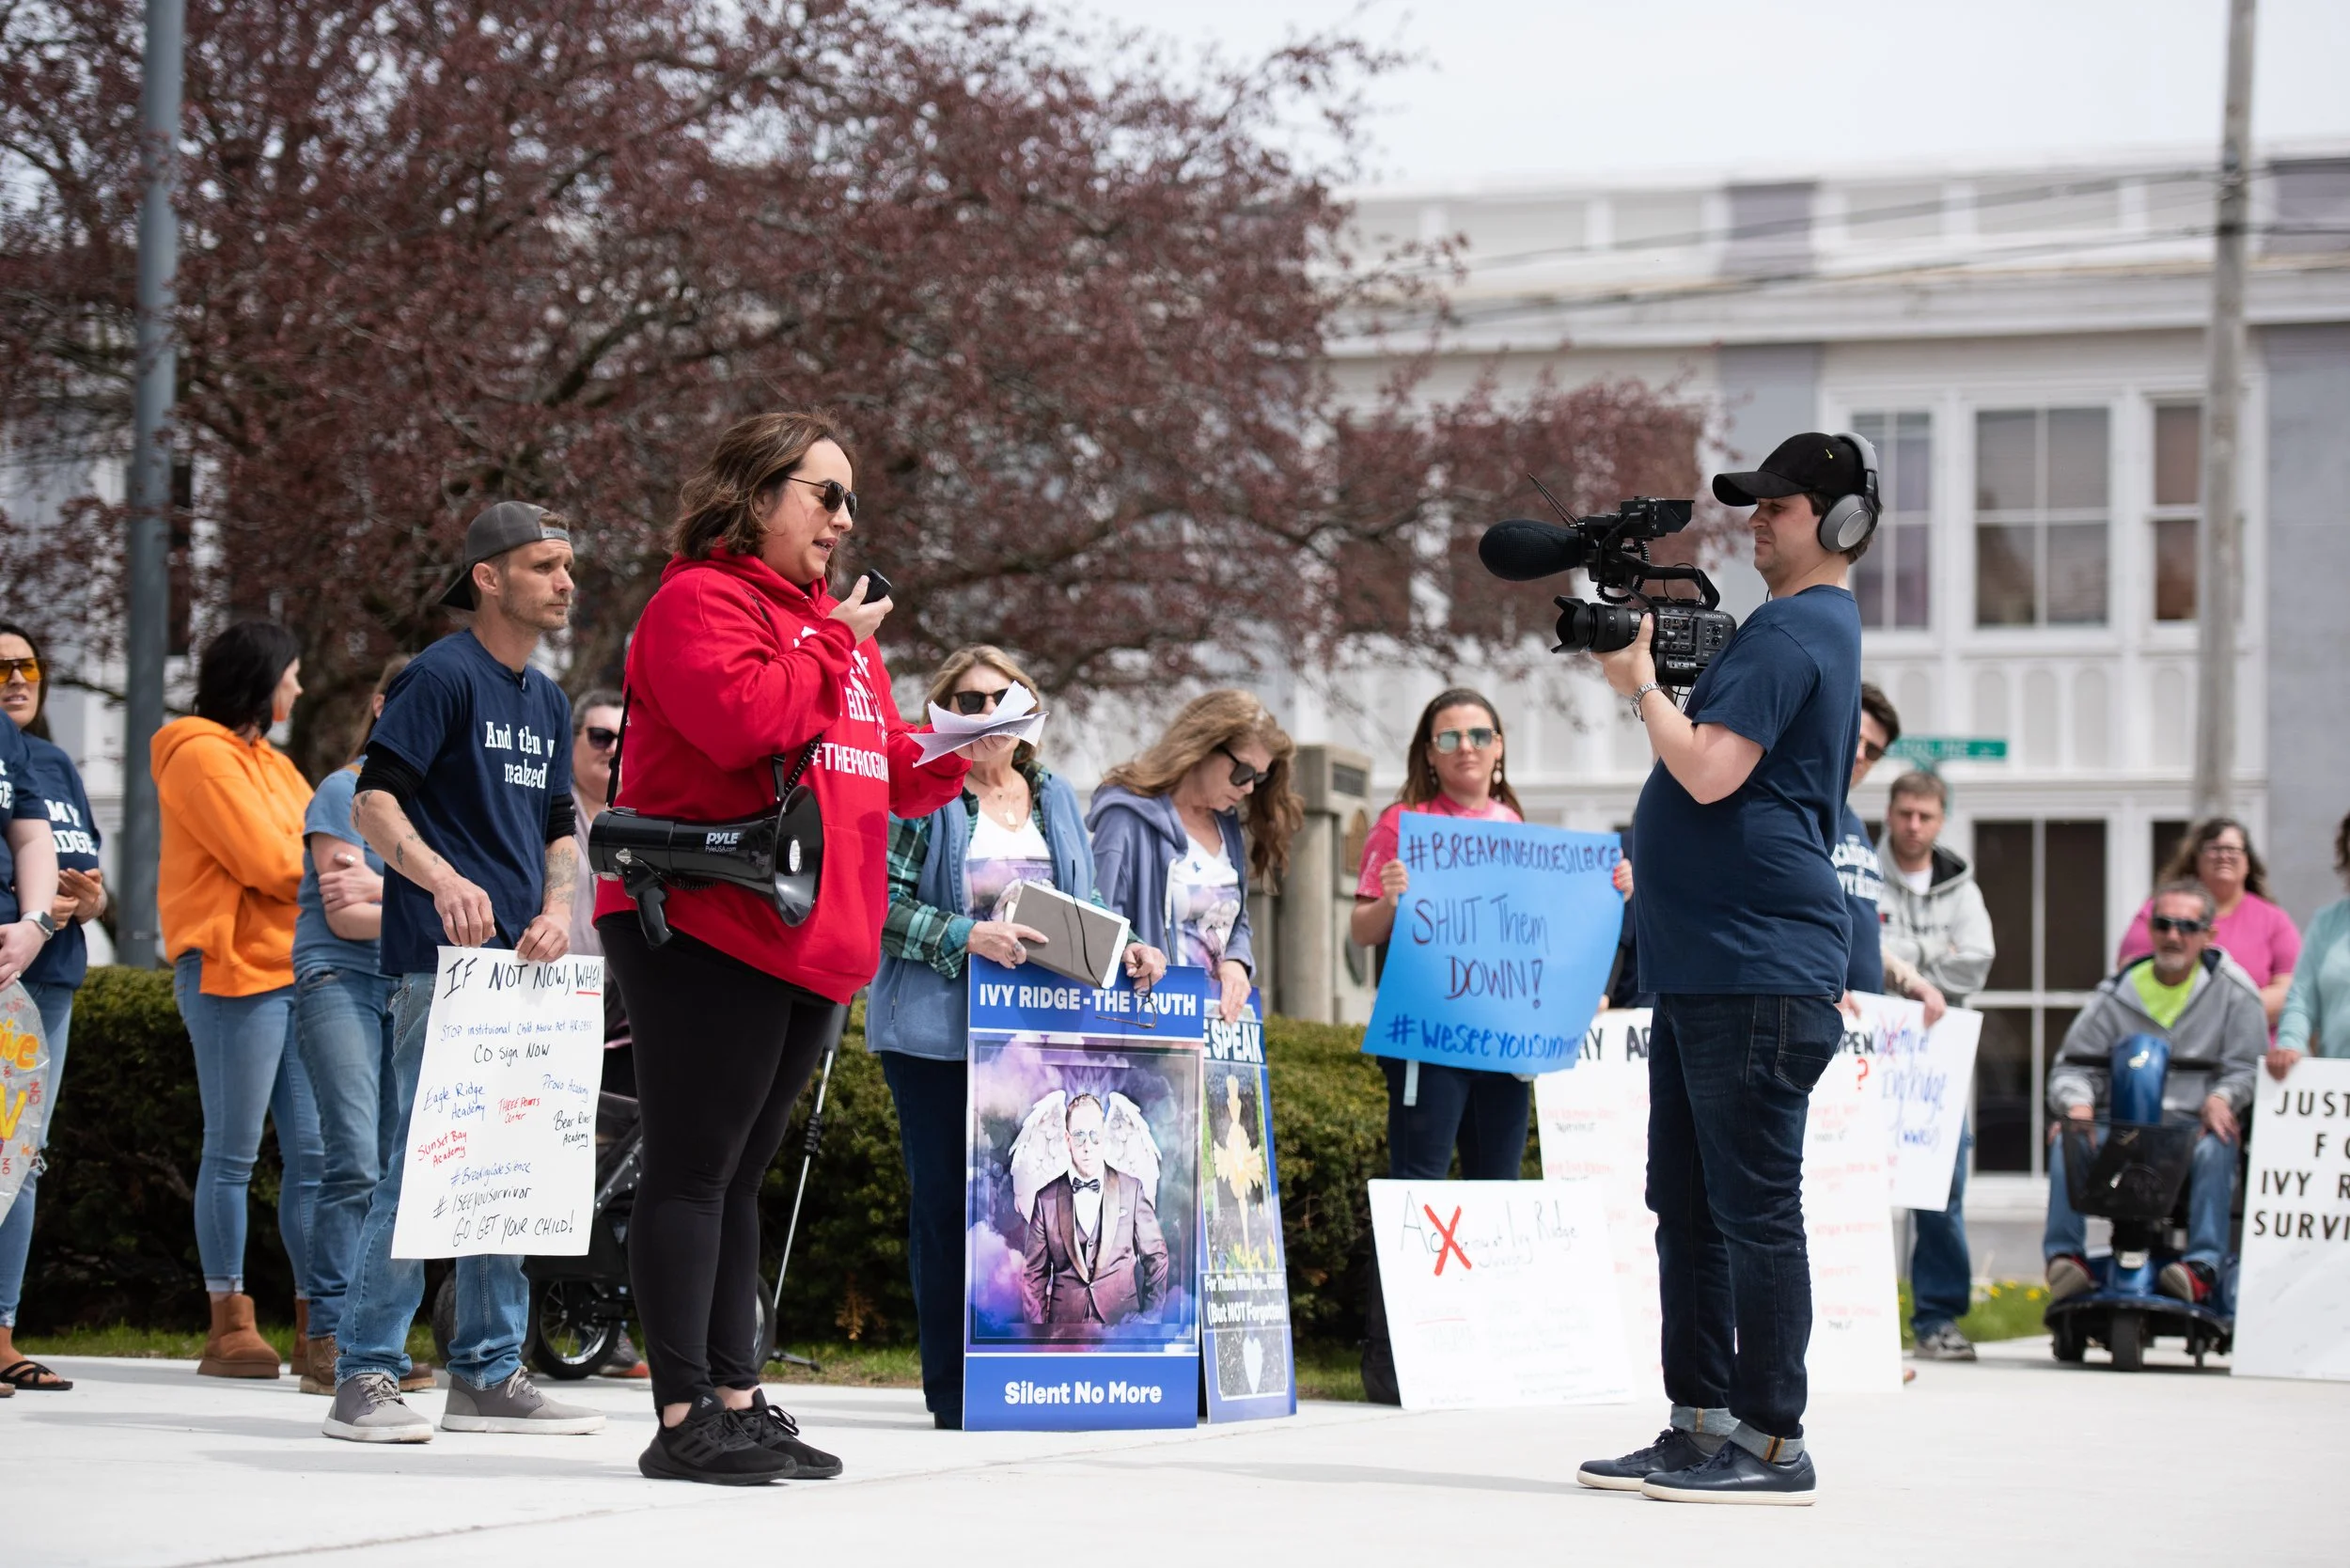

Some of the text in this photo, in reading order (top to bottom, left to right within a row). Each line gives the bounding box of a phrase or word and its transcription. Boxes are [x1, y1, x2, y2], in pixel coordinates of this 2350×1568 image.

[484, 721, 512, 750] And
[706, 832, 741, 845] PYLE
[1412, 893, 1549, 955] SHUT Them
[444, 957, 478, 999] IF
[488, 962, 528, 991] NOT
[533, 962, 571, 996] NOW,
[1444, 955, 1543, 1010] DOWN!
[979, 983, 1015, 1007] IVY
[1134, 992, 1197, 1016] TRUTH
[440, 1024, 462, 1042] STOP
[1211, 1019, 1264, 1063] SPEAK
[1834, 1028, 1875, 1055] PEN
[474, 1043, 493, 1064] CO
[423, 1080, 486, 1114] Eagle Ridge
[451, 1102, 486, 1121] Academy
[451, 1129, 467, 1145] Bay
[563, 1133, 588, 1151] Academy
[432, 1143, 466, 1168] Academy
[2262, 1169, 2312, 1198] IVY
[453, 1209, 574, 1247] GO GET YOUR CHILD!
[2253, 1210, 2350, 1242] SURVI
[1207, 1301, 1228, 1326] (But
[1227, 1301, 1246, 1323] NOT
[1004, 1380, 1163, 1404] Silent No More
